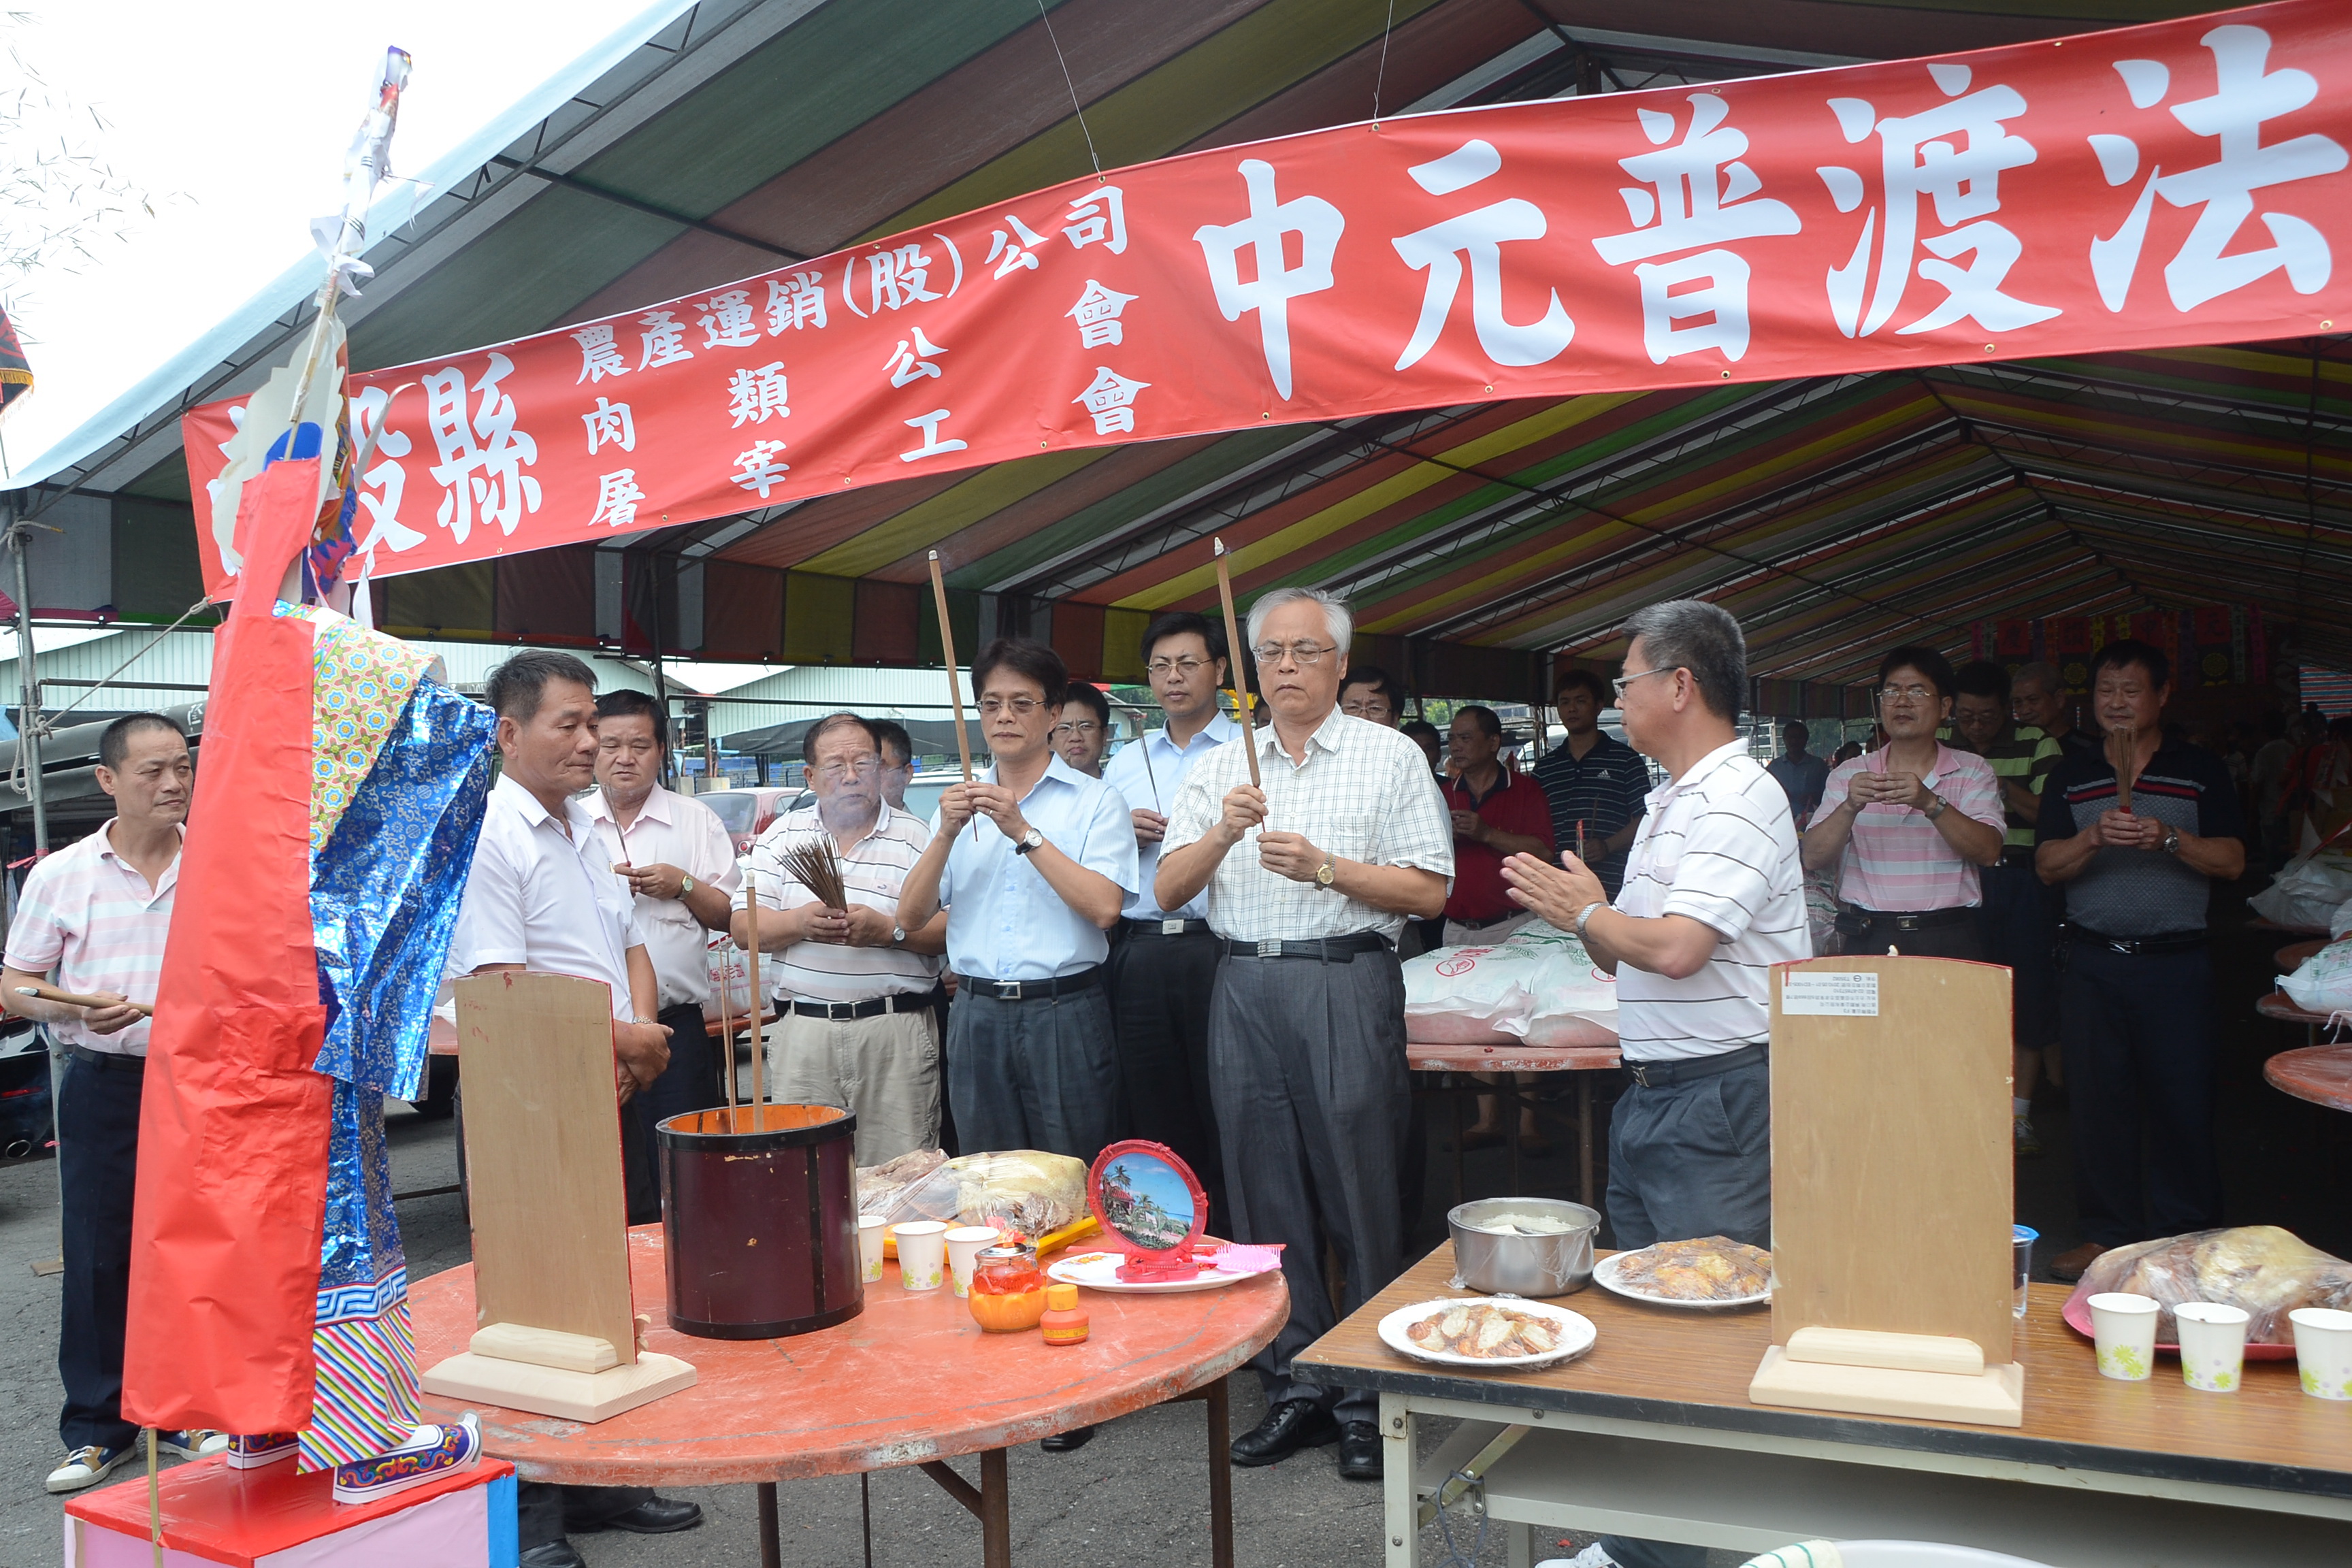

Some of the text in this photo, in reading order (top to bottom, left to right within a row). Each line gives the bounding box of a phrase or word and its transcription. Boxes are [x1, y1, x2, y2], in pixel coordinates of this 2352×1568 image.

[570, 185, 1128, 385] 農產運銷(股)公司
[1192, 24, 2349, 401] 中元普渡法
